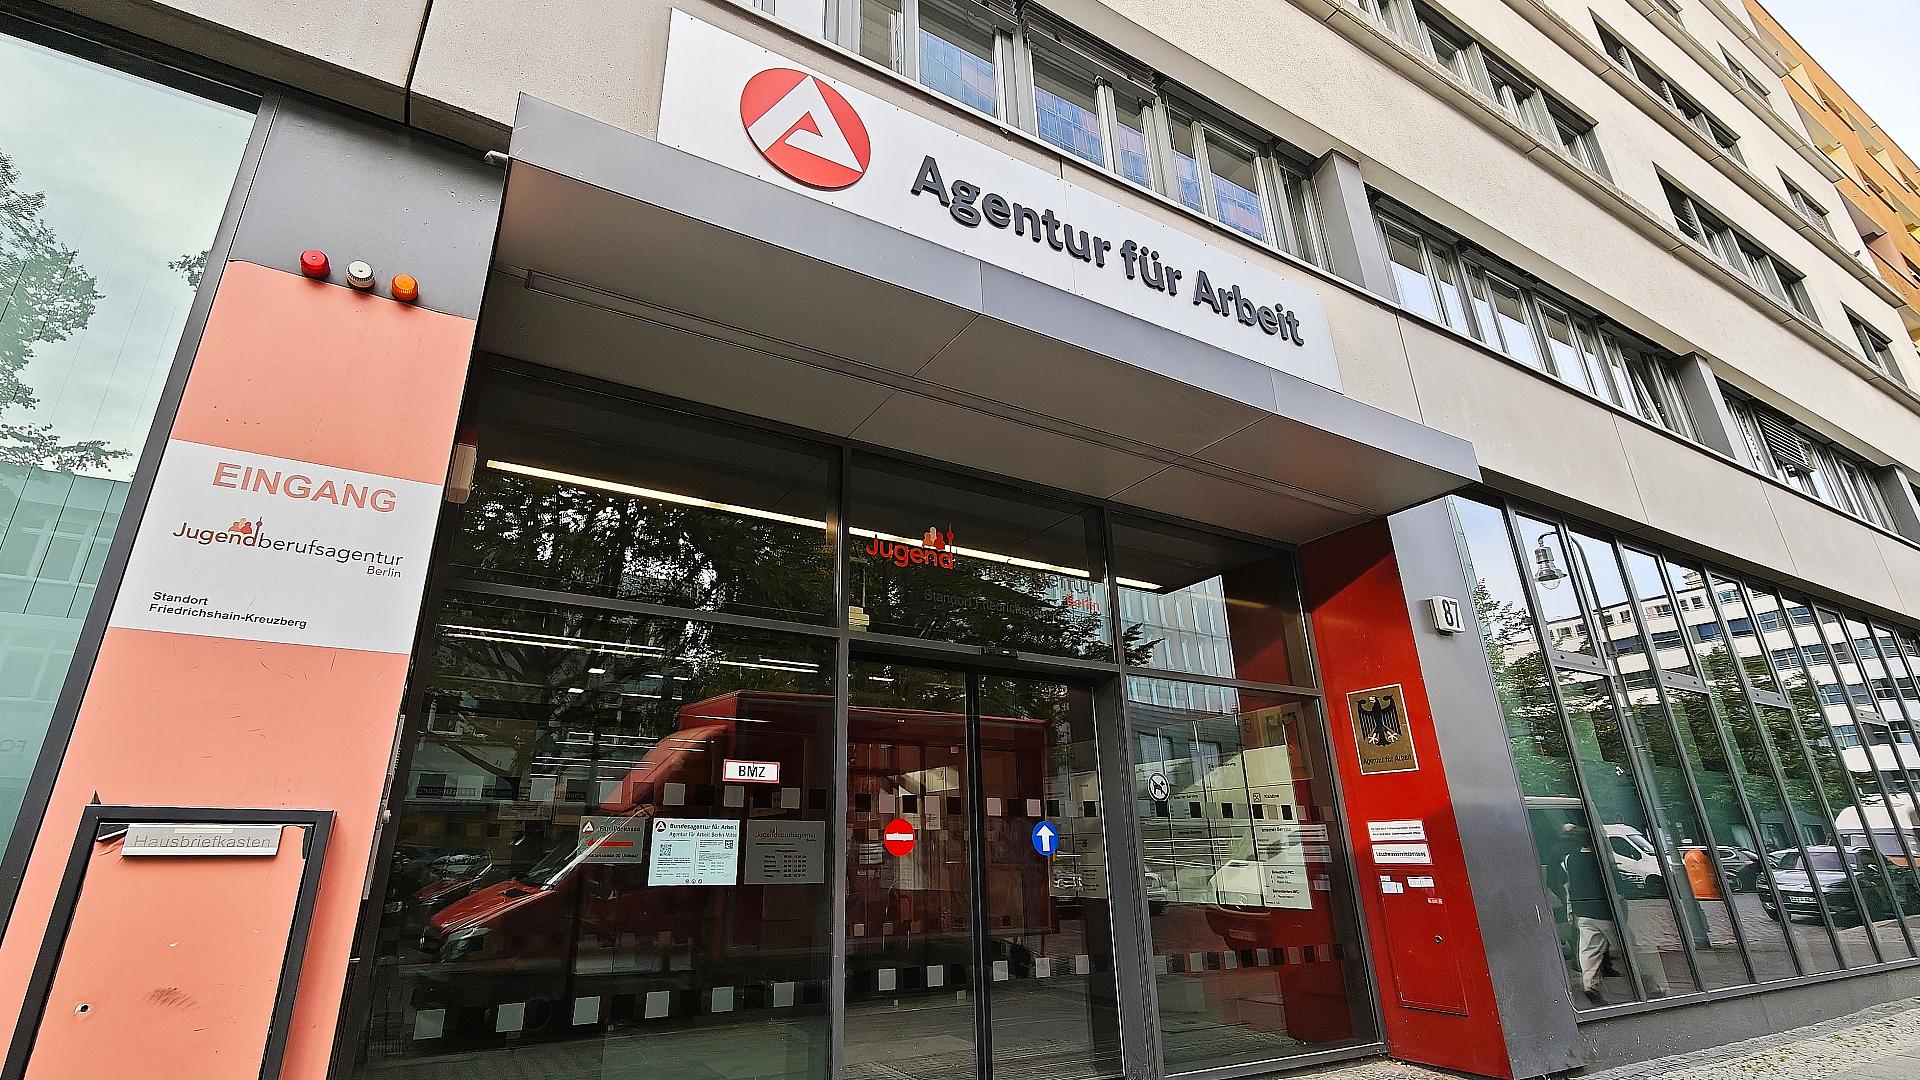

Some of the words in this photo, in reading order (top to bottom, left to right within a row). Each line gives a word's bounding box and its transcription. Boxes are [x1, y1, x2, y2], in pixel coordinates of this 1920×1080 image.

[911, 154, 1110, 268] Agentur
[1120, 240, 1182, 296] für
[1192, 269, 1305, 347] Arbeit
[212, 462, 397, 513] EINGANG
[172, 518, 404, 566] Jugendberufsagentur
[366, 565, 401, 578] Berlin
[153, 591, 208, 606] Standort
[148, 603, 307, 629] Friedrichshain-Kreuzberg
[1441, 599, 1460, 628] 87
[738, 765, 766, 778] BMZ
[133, 834, 271, 849] Hausbriefkasten
